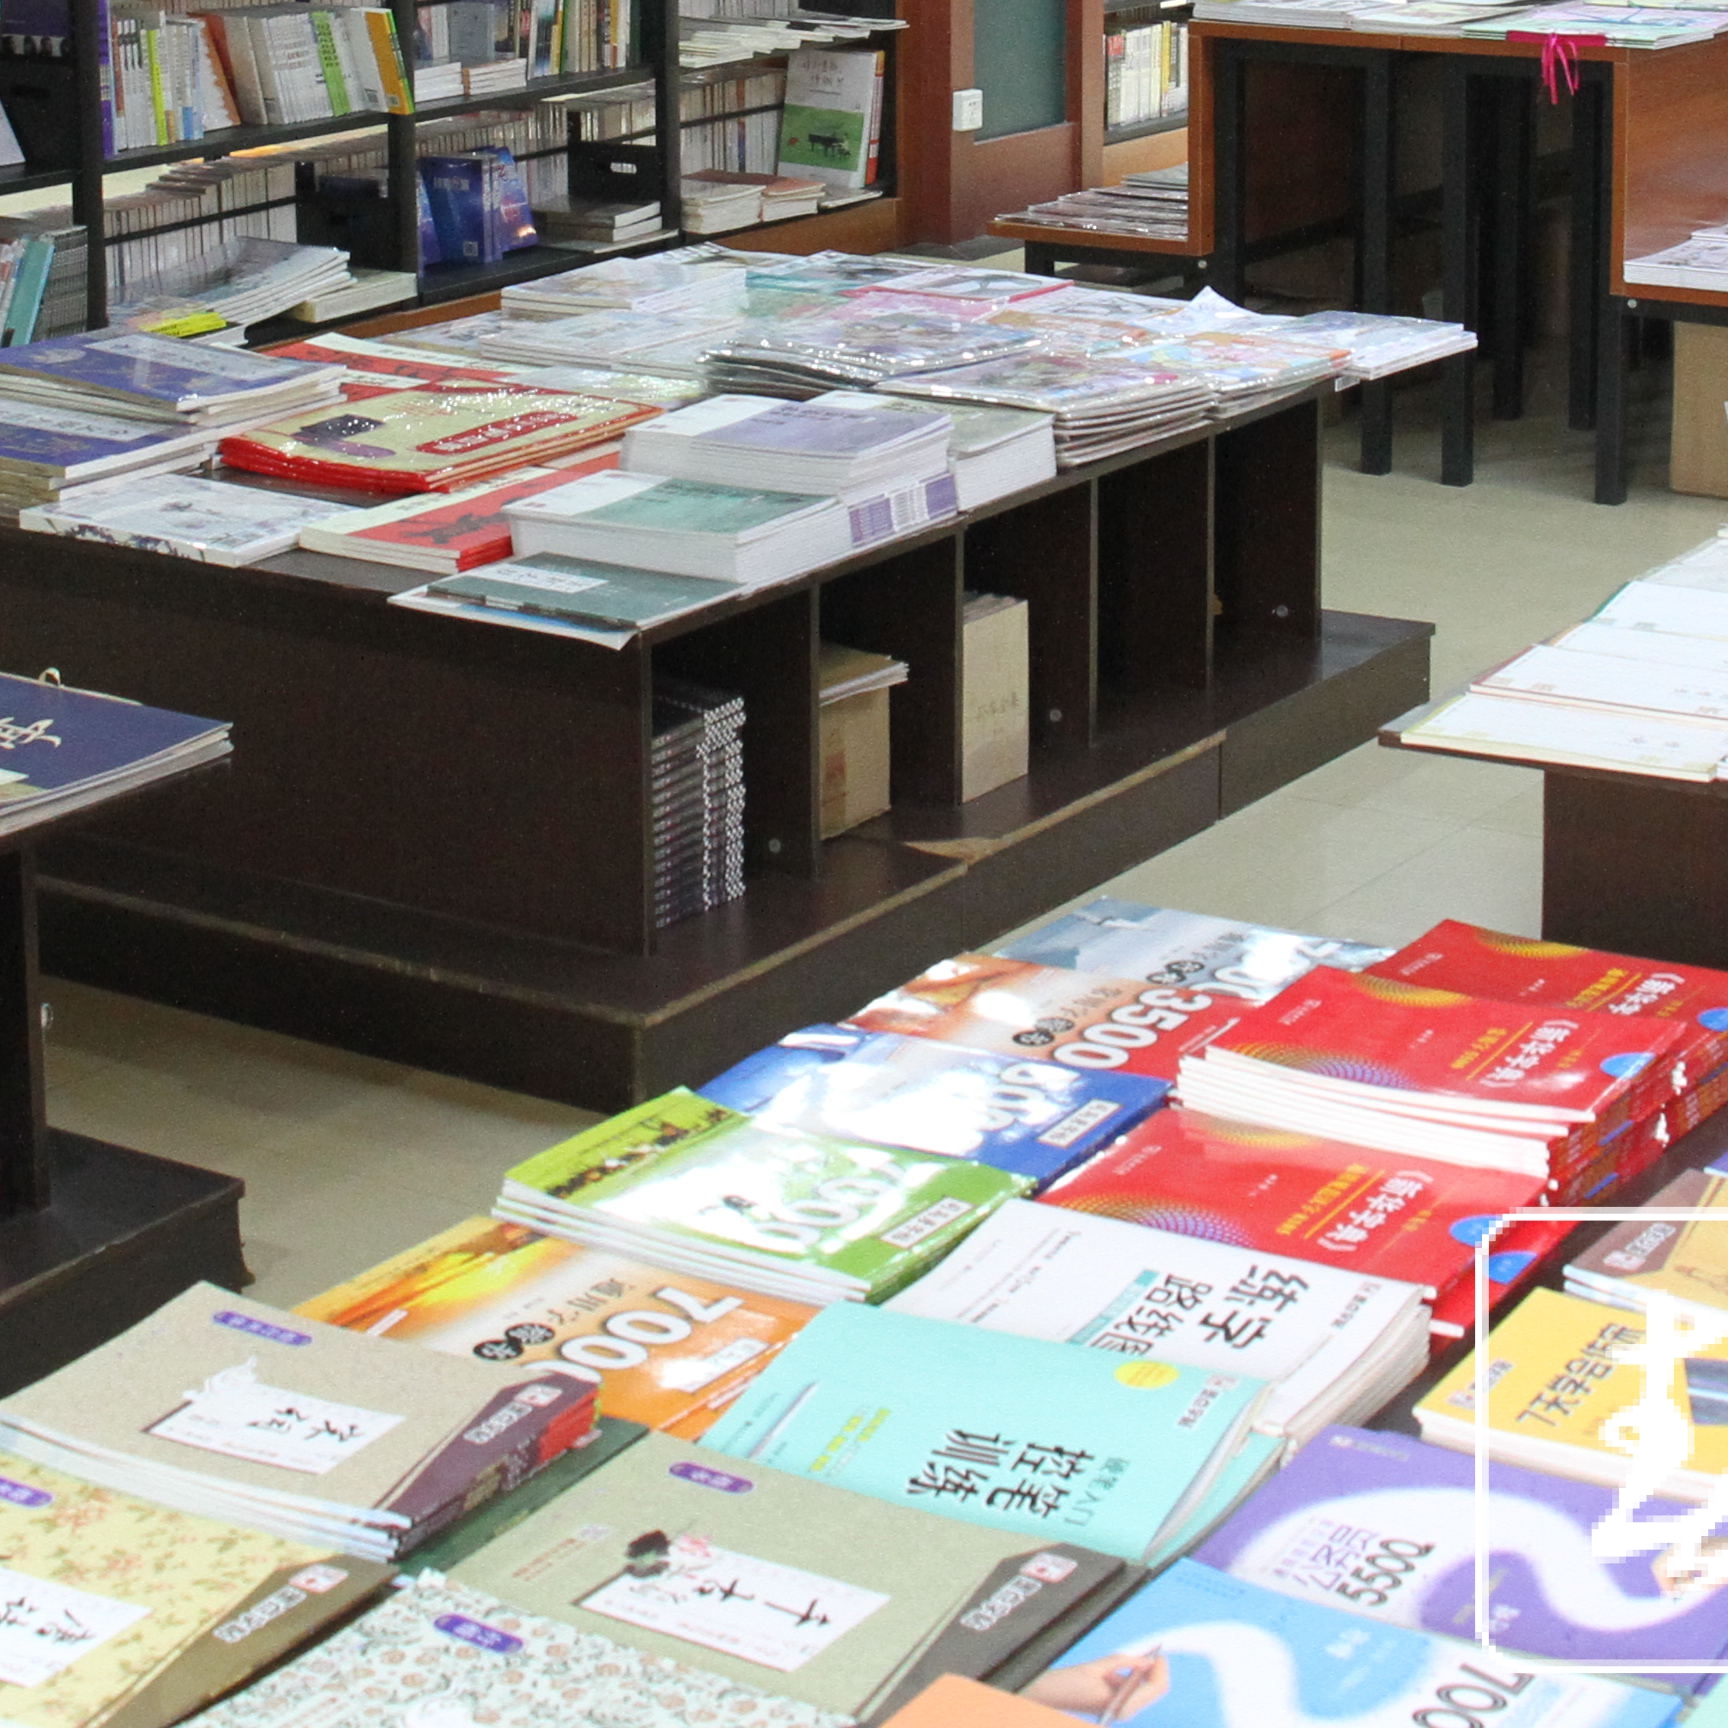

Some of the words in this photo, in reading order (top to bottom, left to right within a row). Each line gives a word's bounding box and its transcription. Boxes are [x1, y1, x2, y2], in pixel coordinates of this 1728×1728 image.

[1054, 987, 1214, 1071] 3500
[1087, 1272, 1195, 1359] 路线图
[1198, 1267, 1314, 1353] 练字
[906, 1425, 1011, 1501] 训练
[985, 1434, 1095, 1523] 控笔
